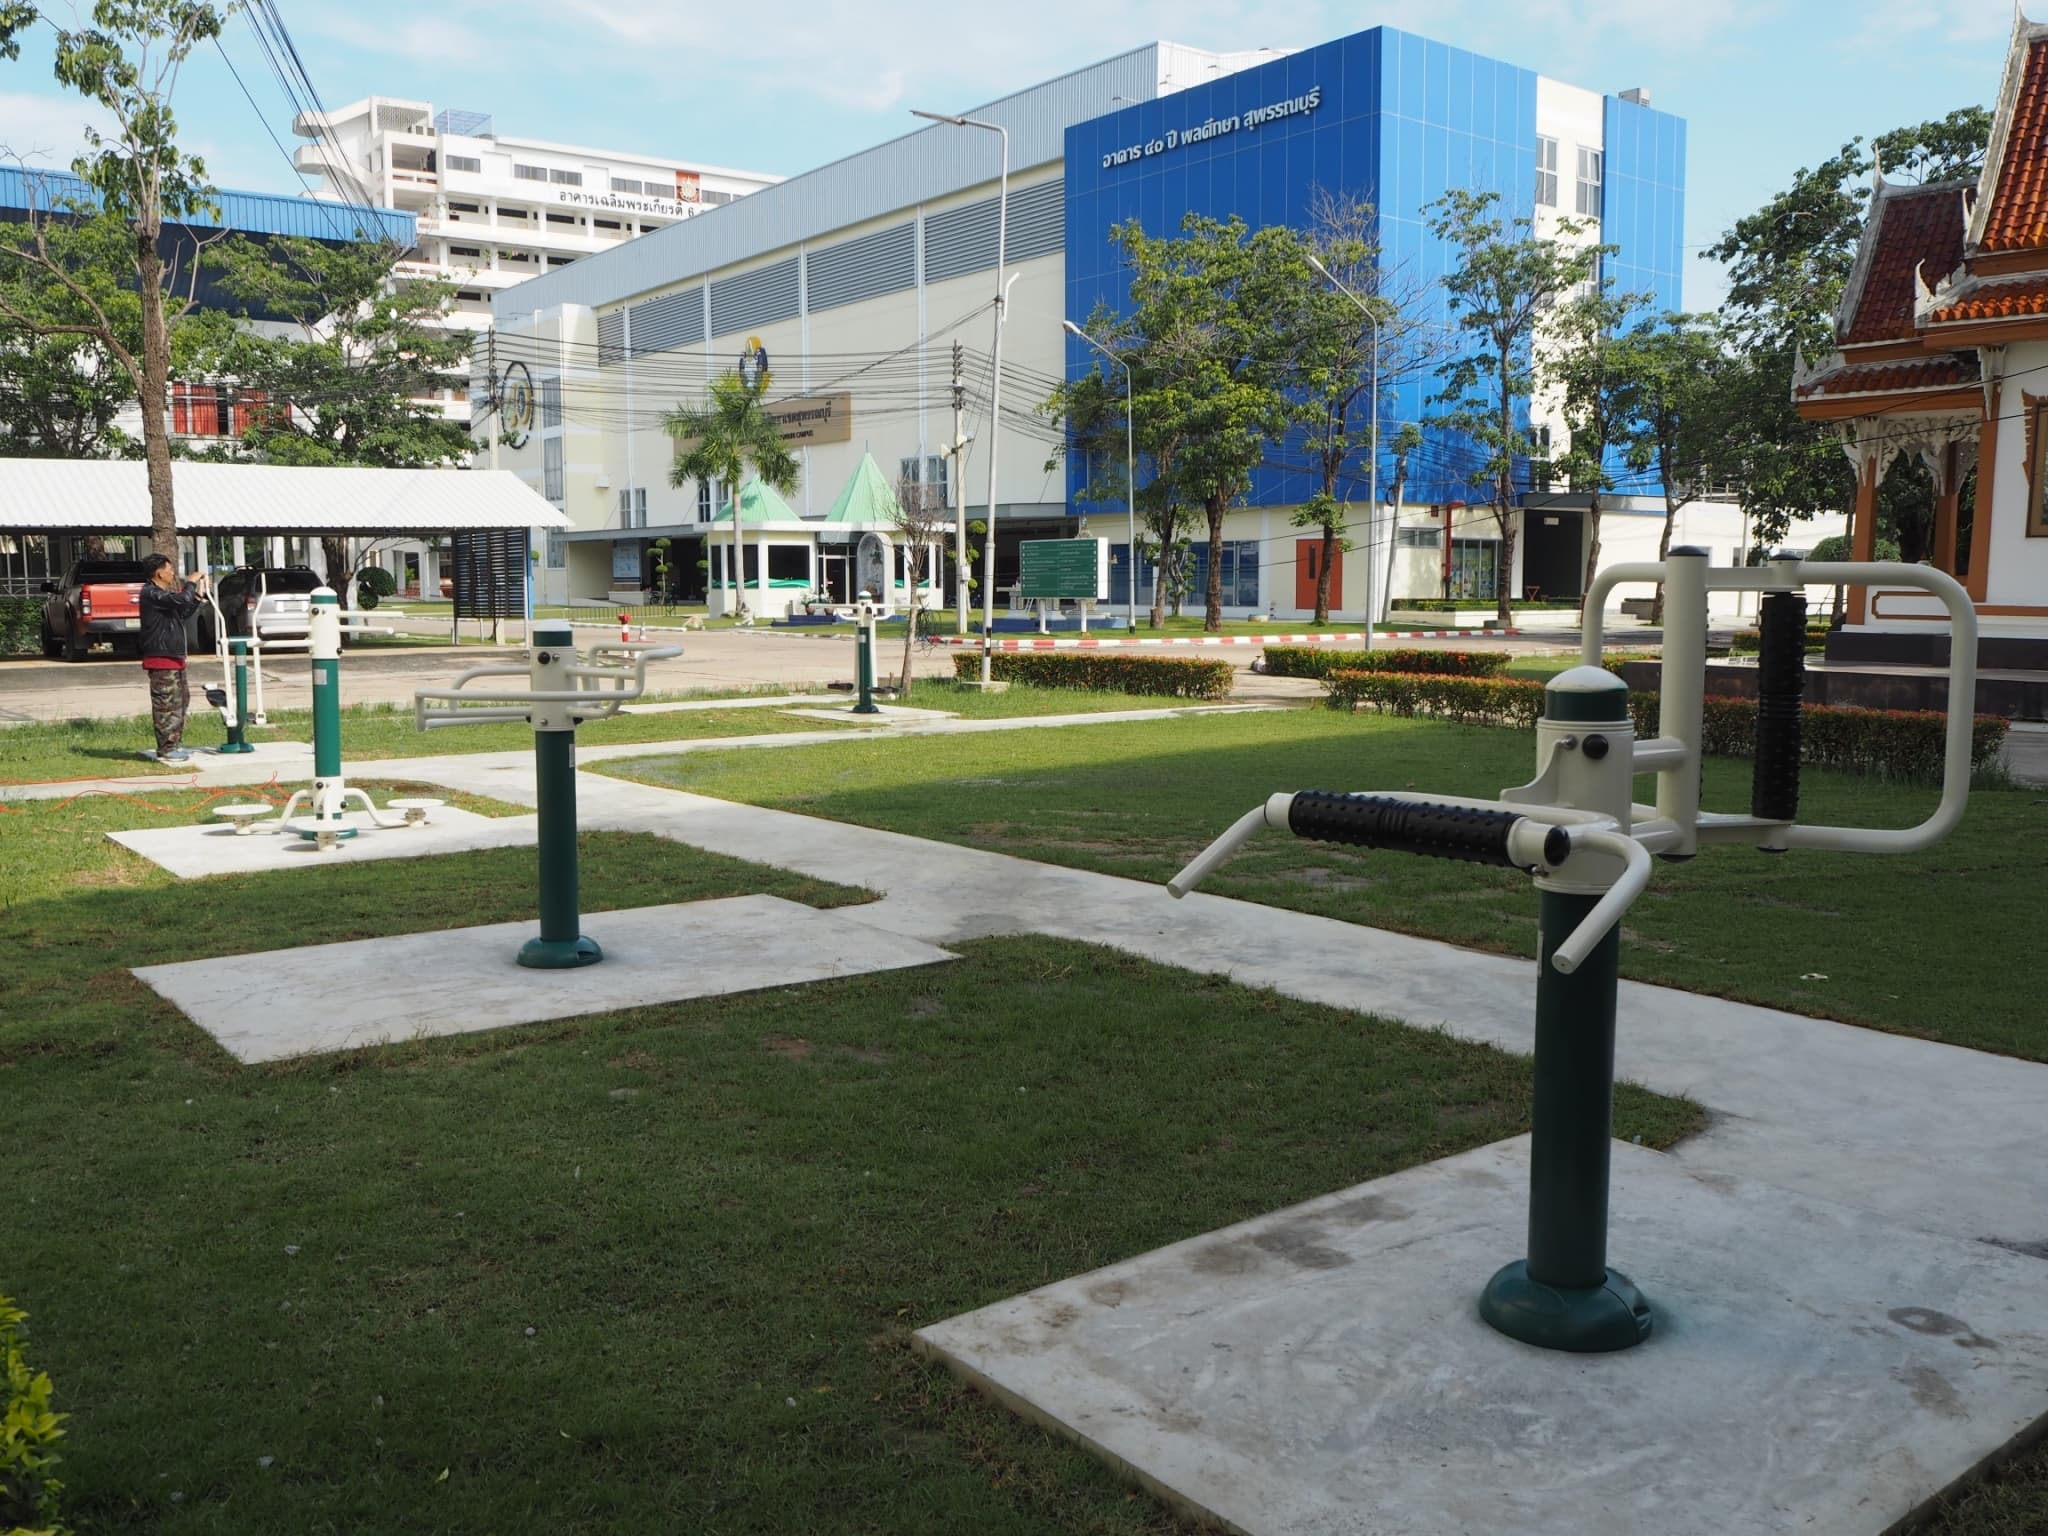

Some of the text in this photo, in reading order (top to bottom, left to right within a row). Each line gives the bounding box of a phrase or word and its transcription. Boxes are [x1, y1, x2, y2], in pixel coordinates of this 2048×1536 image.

[1102, 86, 1321, 168] อาคาร ๔๐ ปี พลศึกษา สุพรรณบุรี
